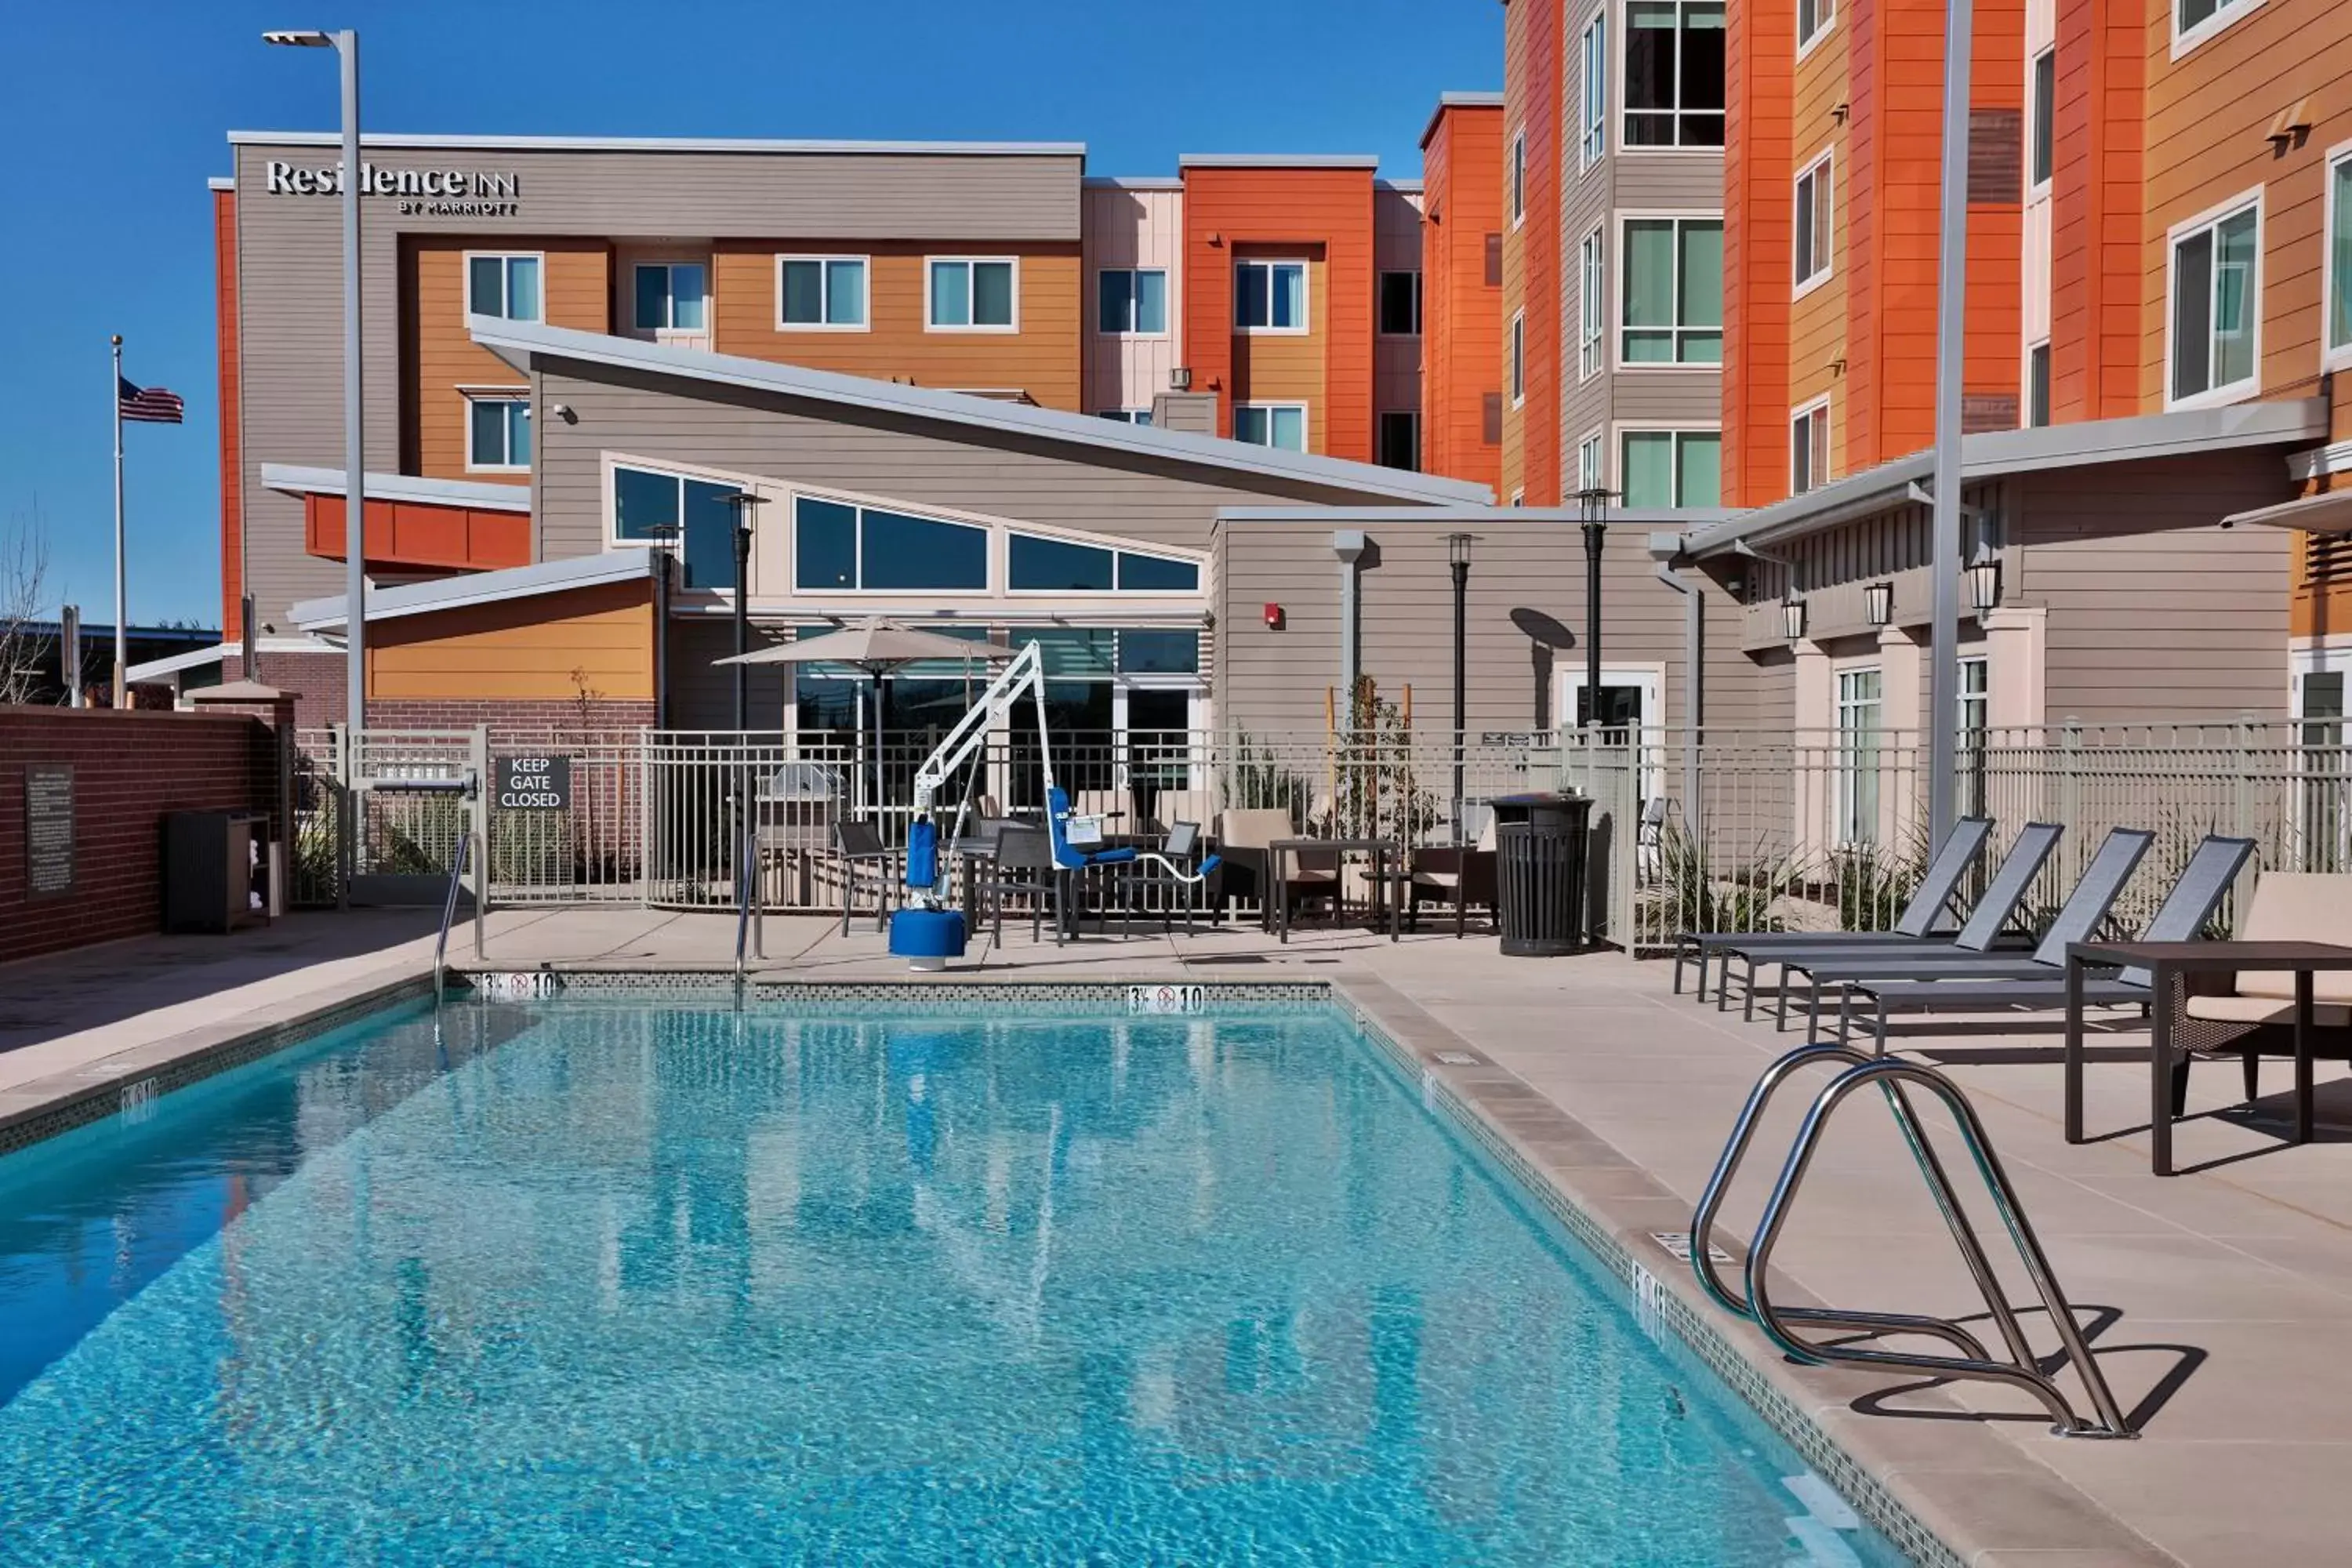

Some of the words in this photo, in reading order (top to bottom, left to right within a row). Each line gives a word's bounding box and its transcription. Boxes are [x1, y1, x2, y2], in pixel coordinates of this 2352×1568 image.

[473, 171, 515, 195] INN
[399, 200, 422, 212] BY
[427, 201, 519, 215] MARRIOTT
[512, 758, 550, 772] KEEP
[510, 775, 550, 789] GATE
[502, 793, 561, 807] CLOSED
